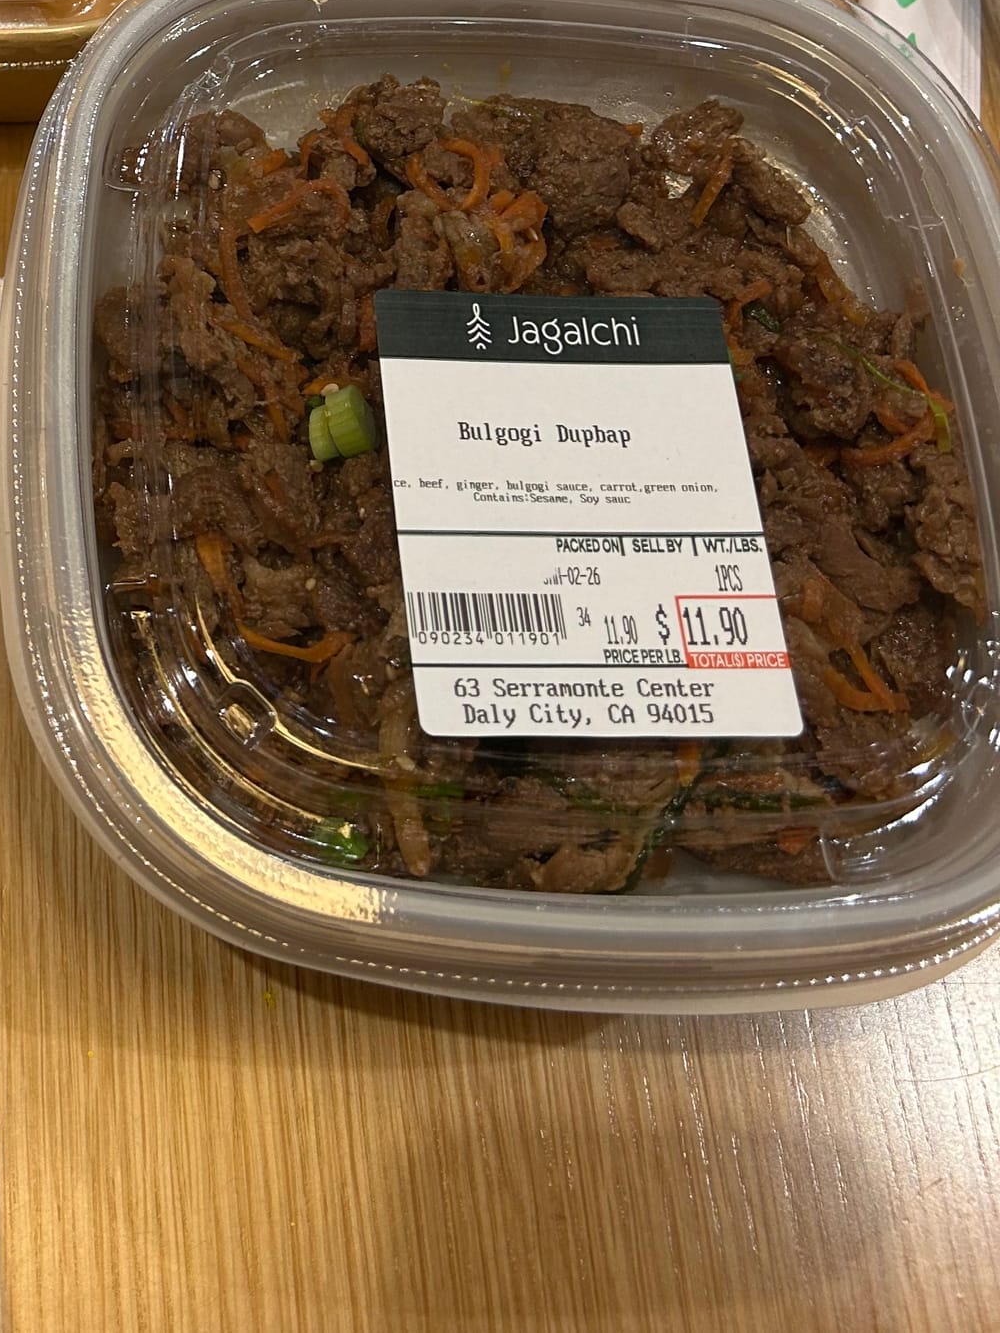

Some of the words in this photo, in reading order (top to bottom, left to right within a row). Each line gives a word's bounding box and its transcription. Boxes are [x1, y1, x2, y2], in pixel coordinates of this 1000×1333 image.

[508, 316, 640, 354] Jagalchi
[457, 421, 542, 446] Bulgogi
[555, 424, 630, 448] Dupbap
[418, 477, 448, 489] beef,
[456, 479, 499, 493] ginger,
[505, 479, 549, 493] bulgogi
[555, 483, 592, 492] sauce,
[680, 481, 718, 493] onion,
[579, 491, 599, 506] Soy
[556, 538, 600, 553] PACKED
[602, 538, 619, 553] ON
[632, 537, 664, 553] SELL
[665, 538, 682, 553] BY
[702, 538, 762, 553] WT./LBS.
[714, 564, 743, 591] 1PCS
[576, 606, 591, 626] 34
[655, 603, 670, 645] $
[682, 606, 748, 645] 11.90
[415, 628, 484, 645] 090234
[492, 629, 559, 645] 011901
[604, 615, 638, 644] 11.90
[603, 649, 639, 664] PRICE
[640, 649, 664, 663] PER
[665, 648, 683, 663] LB.
[690, 653, 744, 667] TOTAL($)
[746, 653, 785, 667] PRICE
[453, 678, 480, 697] 63
[492, 678, 624, 697] Serramonte
[636, 678, 714, 697] Center
[462, 703, 516, 728] Daly
[528, 703, 591, 728] City,
[607, 703, 635, 723] CA
[646, 703, 714, 723] 94015
